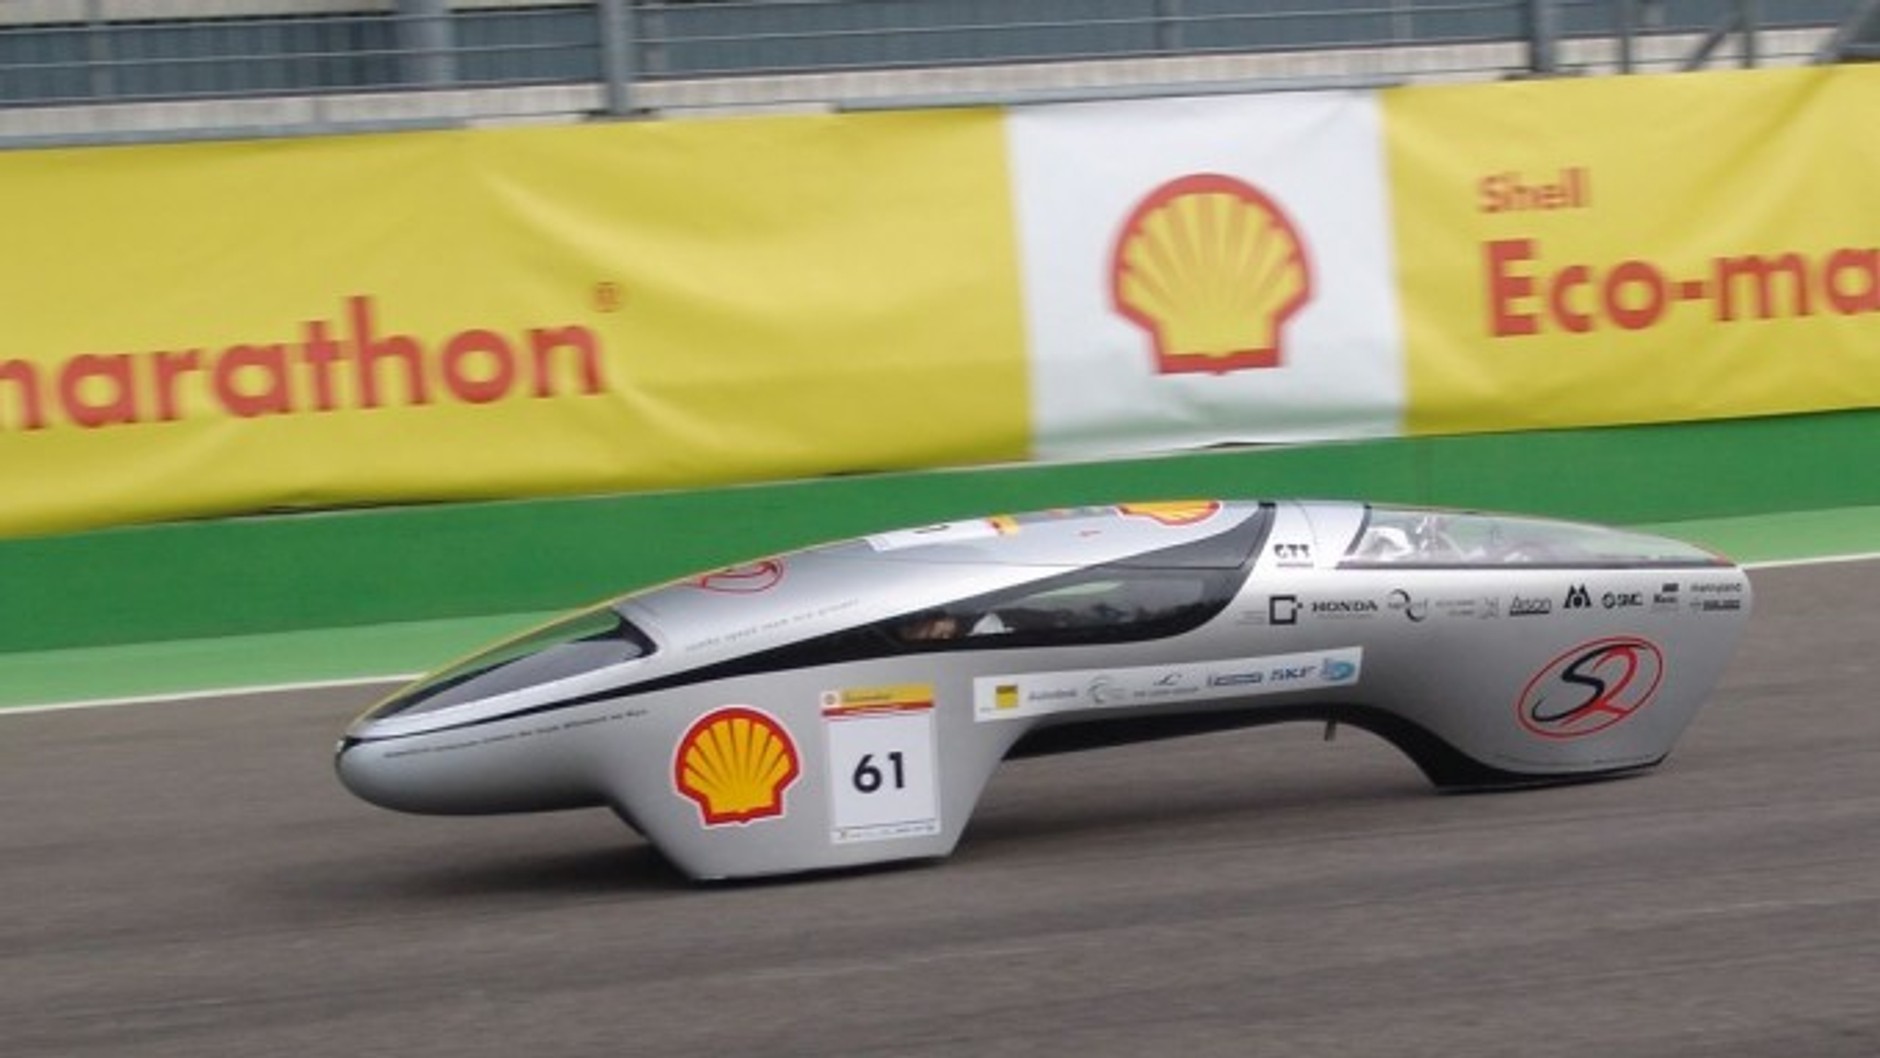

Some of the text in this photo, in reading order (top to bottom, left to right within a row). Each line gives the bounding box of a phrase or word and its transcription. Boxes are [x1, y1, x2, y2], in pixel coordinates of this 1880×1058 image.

[1479, 167, 1589, 213] Shell
[1312, 600, 1378, 613] HONDA
[852, 750, 906, 795] 61
